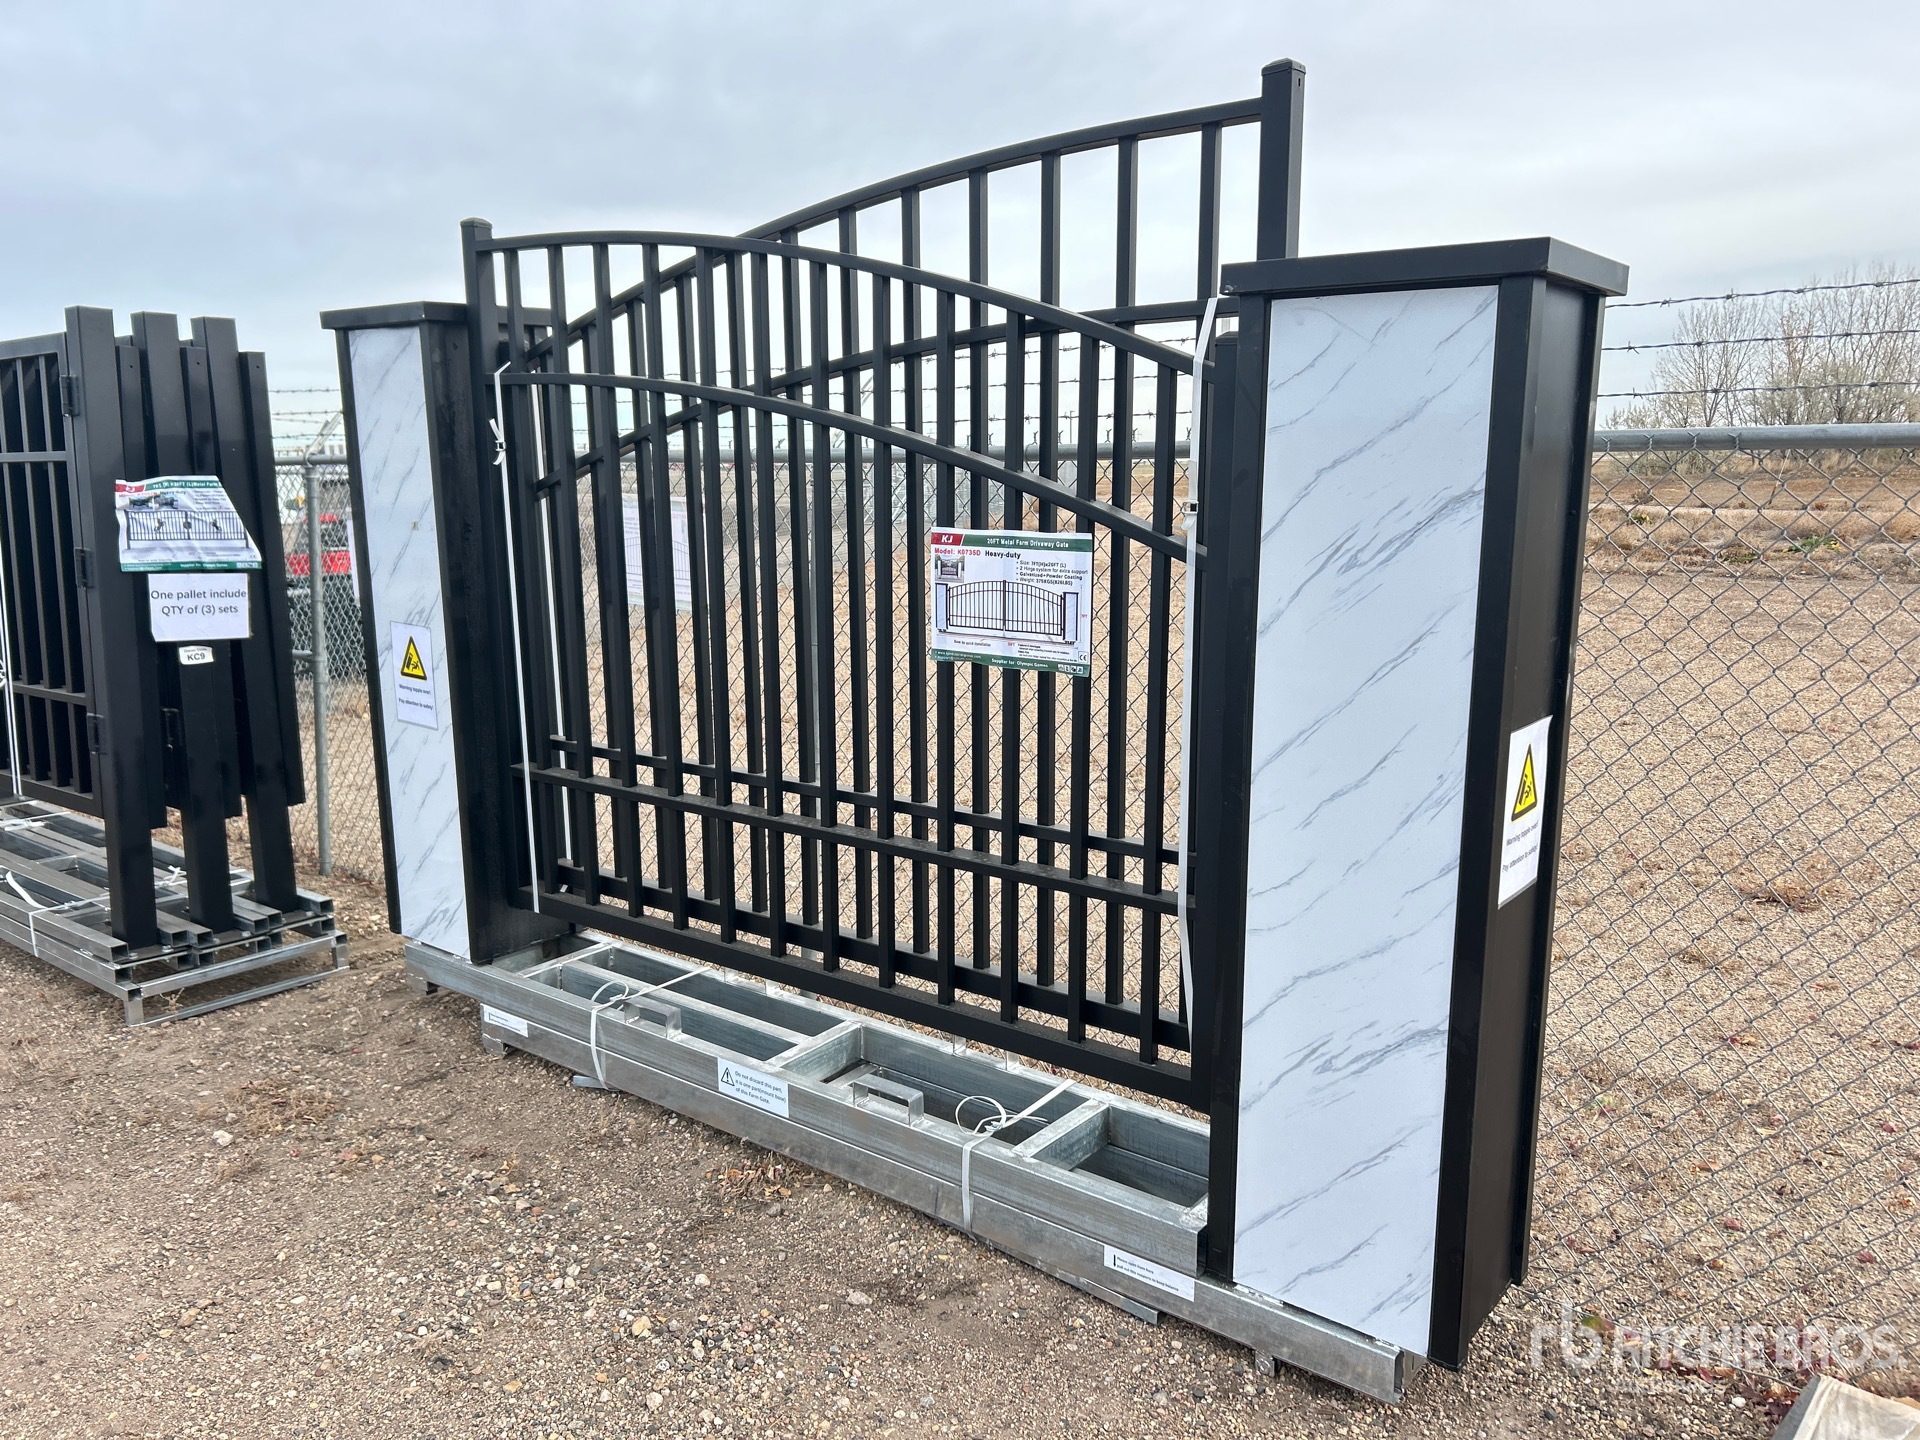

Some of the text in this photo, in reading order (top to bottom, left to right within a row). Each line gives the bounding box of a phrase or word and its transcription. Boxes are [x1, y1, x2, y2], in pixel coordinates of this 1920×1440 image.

[941, 535, 953, 543] KJ
[1030, 540, 1054, 548] Driveway
[985, 550, 1021, 559] Heavy-duty
[151, 589, 247, 600] One pallet include
[161, 604, 238, 616] QTY of (3) sets
[187, 652, 205, 661] KC9
[1506, 833, 1520, 846] Warning
[1521, 826, 1530, 838] topple
[1509, 854, 1524, 868] attention
[749, 1077, 763, 1086] discard
